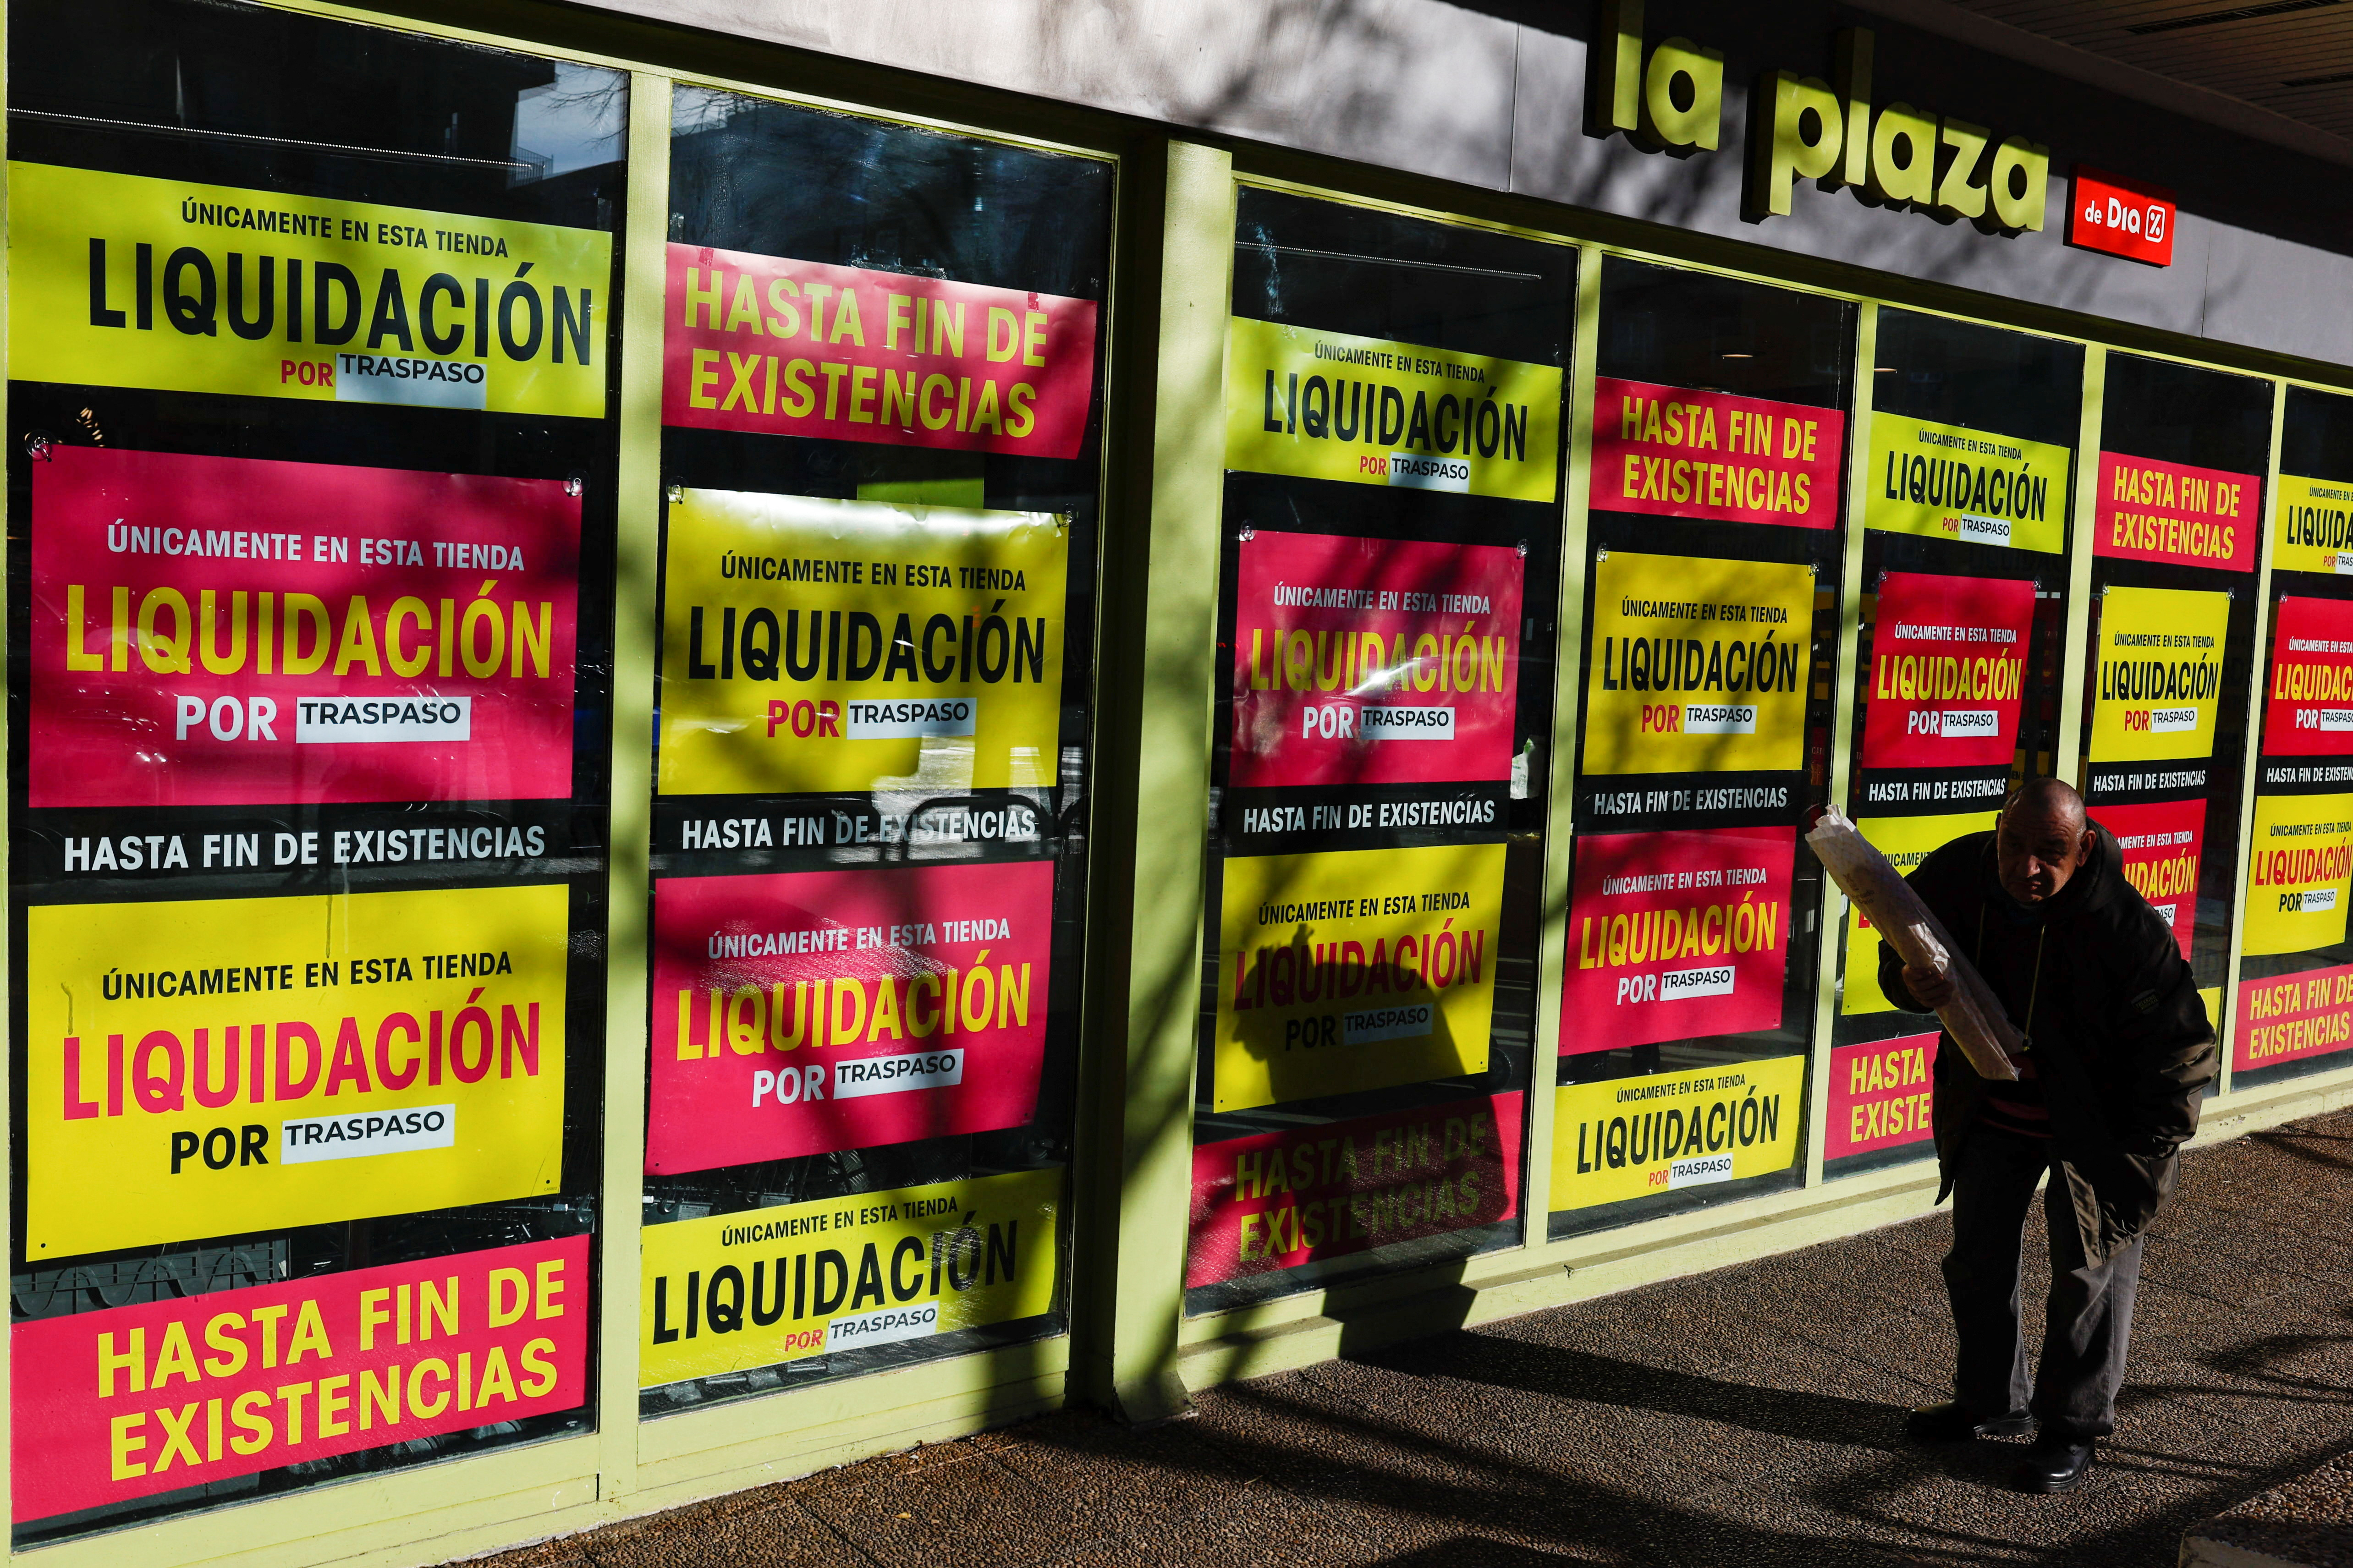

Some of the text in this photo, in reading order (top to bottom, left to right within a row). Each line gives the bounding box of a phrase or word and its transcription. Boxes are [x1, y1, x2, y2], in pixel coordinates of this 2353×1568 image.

[1605, 0, 2050, 232] la plaza
[182, 197, 508, 258] ÚNICAMENTE EN ESTA TIENDA
[2085, 200, 2102, 225] de
[90, 238, 590, 366] LIQUIDACIÓN
[685, 267, 1047, 367] HASTA FIN DE
[280, 353, 485, 387] POR TRASPASO
[1315, 340, 1484, 383] ÚNICAMENTE EN ESTA TIENDA
[689, 348, 1036, 437] EXISTENCIAS
[1264, 369, 1527, 461] LIQUIDACIÓN
[1622, 396, 1817, 461] HASTA FIN DE
[1919, 428, 2022, 460] ÚNICAMENTE EN ESTA TIENDA
[1360, 455, 1468, 480] POR TRASPASO
[1623, 454, 1810, 514] EXISTENCIAS
[1886, 451, 2047, 521] LIQUIDACIÓN
[2114, 466, 2240, 517] HASTA FIN DE
[107, 518, 524, 570] ÚNICAMENTE EN ESTA TIENDA
[1943, 517, 2009, 536] POR TRASPASO
[2112, 512, 2234, 559] EXISTENCIAS
[721, 550, 1026, 591] ÚNICAMENTE EN ESTA TIENDA
[1274, 581, 1490, 614] ÚNICAMENTE EN ESTA TIENDA
[1622, 596, 1787, 623] ÚNICAMENTE EN ESTA TIENDA
[67, 580, 551, 679] LIQUIDACIÓN
[688, 599, 1045, 683] LIQUIDACIÓN
[1895, 621, 2017, 643] ÚNICAMENTE EN ESTA TIENDA
[2114, 630, 2214, 648] ÚNICAMENTE EN ESTA TIENDA
[1250, 621, 1505, 693] LIQUIDACIÓN
[1603, 630, 1798, 692] LIQUIDACIÓN
[1878, 648, 2022, 700] LIQUIDACIÓN
[2102, 653, 2219, 701] LIQUIDACIÓN
[176, 695, 460, 741] POR TRASPASO
[767, 700, 969, 738] POR TRASPASO
[1303, 706, 1449, 739] POR TRASPASO
[1642, 705, 1752, 732] POR TRASPASO
[1908, 711, 1993, 735] POR TRASPASO
[2124, 710, 2194, 731] POR TRASPASO
[1244, 800, 1495, 833] HASTA FIN DE EXISTENCIAS
[1594, 787, 1787, 815] HASTA FIN DE EXISTENCIAS
[65, 826, 545, 871] HASTA FIN DE EXISTENCIAS
[682, 810, 1036, 849] HASTA FIN DE EXISTENCIAS
[2270, 821, 2352, 837] ÚNICAMENTE EN ESTA TIENDA
[1603, 868, 1766, 895] ÚNICAMENTE EN ESTA TIENDA
[2255, 837, 2353, 886] LIQUIDACIÓN
[1259, 892, 1469, 925] ÚNICAMENTE EN ESTA TIENDA
[1579, 891, 1777, 970] LIQUIDACIÓN
[708, 918, 1010, 959] ÚNICAMENTE EN ESTA TIENDA
[103, 951, 512, 1001] ÚNICAMENTE EN ESTA TIENDA
[1234, 918, 1484, 1010] LIQUIDACIÓN
[1617, 970, 1730, 1005] POR TRASPASO
[677, 949, 1030, 1061] LIQUIDACIÓN
[2250, 974, 2353, 1020] HASTA FIN DE
[1286, 1007, 1428, 1051] POR TRASPASO
[2249, 1011, 2350, 1059] EXISTENCIAS
[63, 987, 539, 1120] LIQUIDACIÓN
[752, 1054, 956, 1107] POR TRASPASO
[1617, 1074, 1745, 1103] ÚNICAMENTE EN ESTA TIENDA
[171, 1111, 444, 1174] POR TRASPASO
[1577, 1085, 1779, 1174] LIQUIDACIÓN
[1649, 1158, 1731, 1186] POR TRASPASO
[722, 1196, 958, 1247] ÚNICAMENTE EN ESTA TIENDA
[653, 1211, 1017, 1345] LIQUIDACIÓN
[98, 1259, 565, 1398] HASTA FIN DE
[785, 1309, 936, 1352] POR TRASPASO
[111, 1337, 558, 1481] EXISTENCIAS
